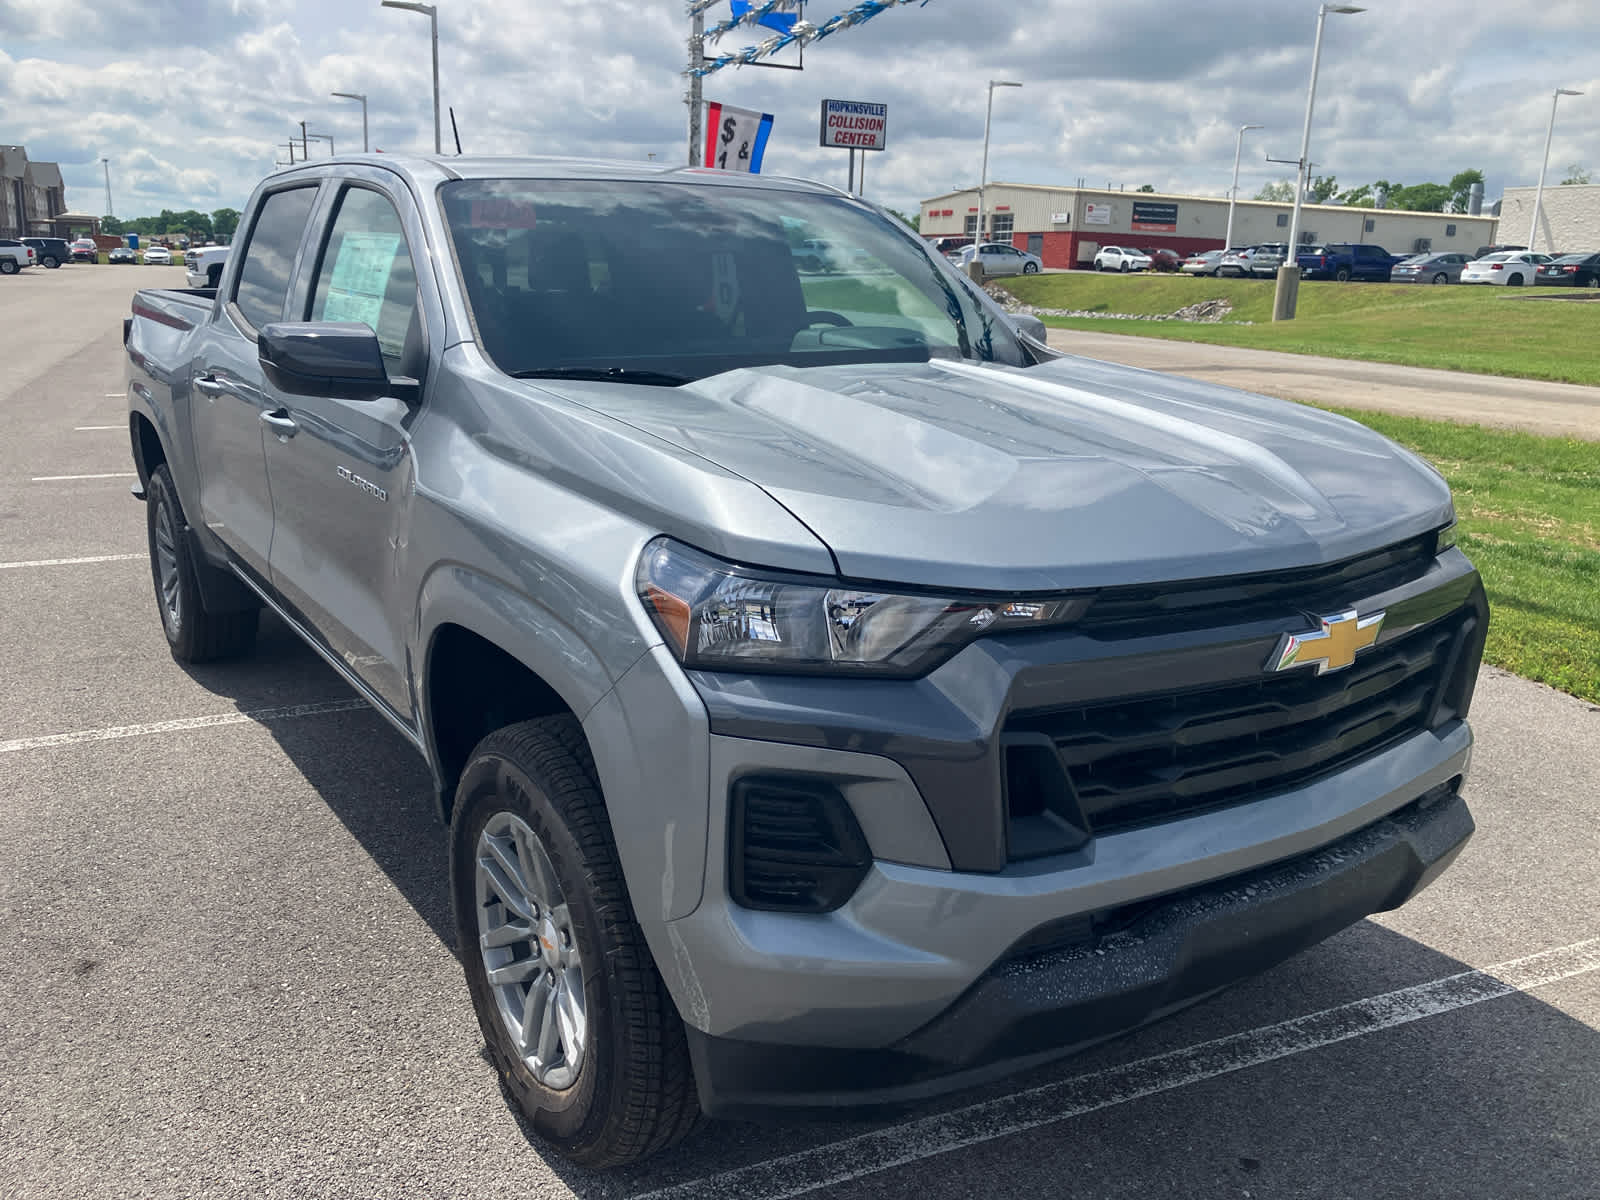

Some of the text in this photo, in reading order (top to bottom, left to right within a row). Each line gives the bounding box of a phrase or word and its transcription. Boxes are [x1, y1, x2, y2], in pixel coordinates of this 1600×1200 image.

[829, 101, 885, 116] HOPKINSVILLE
[828, 115, 884, 131] COLLISION
[834, 130, 876, 146] CENTER
[337, 465, 386, 502] COLORADO
